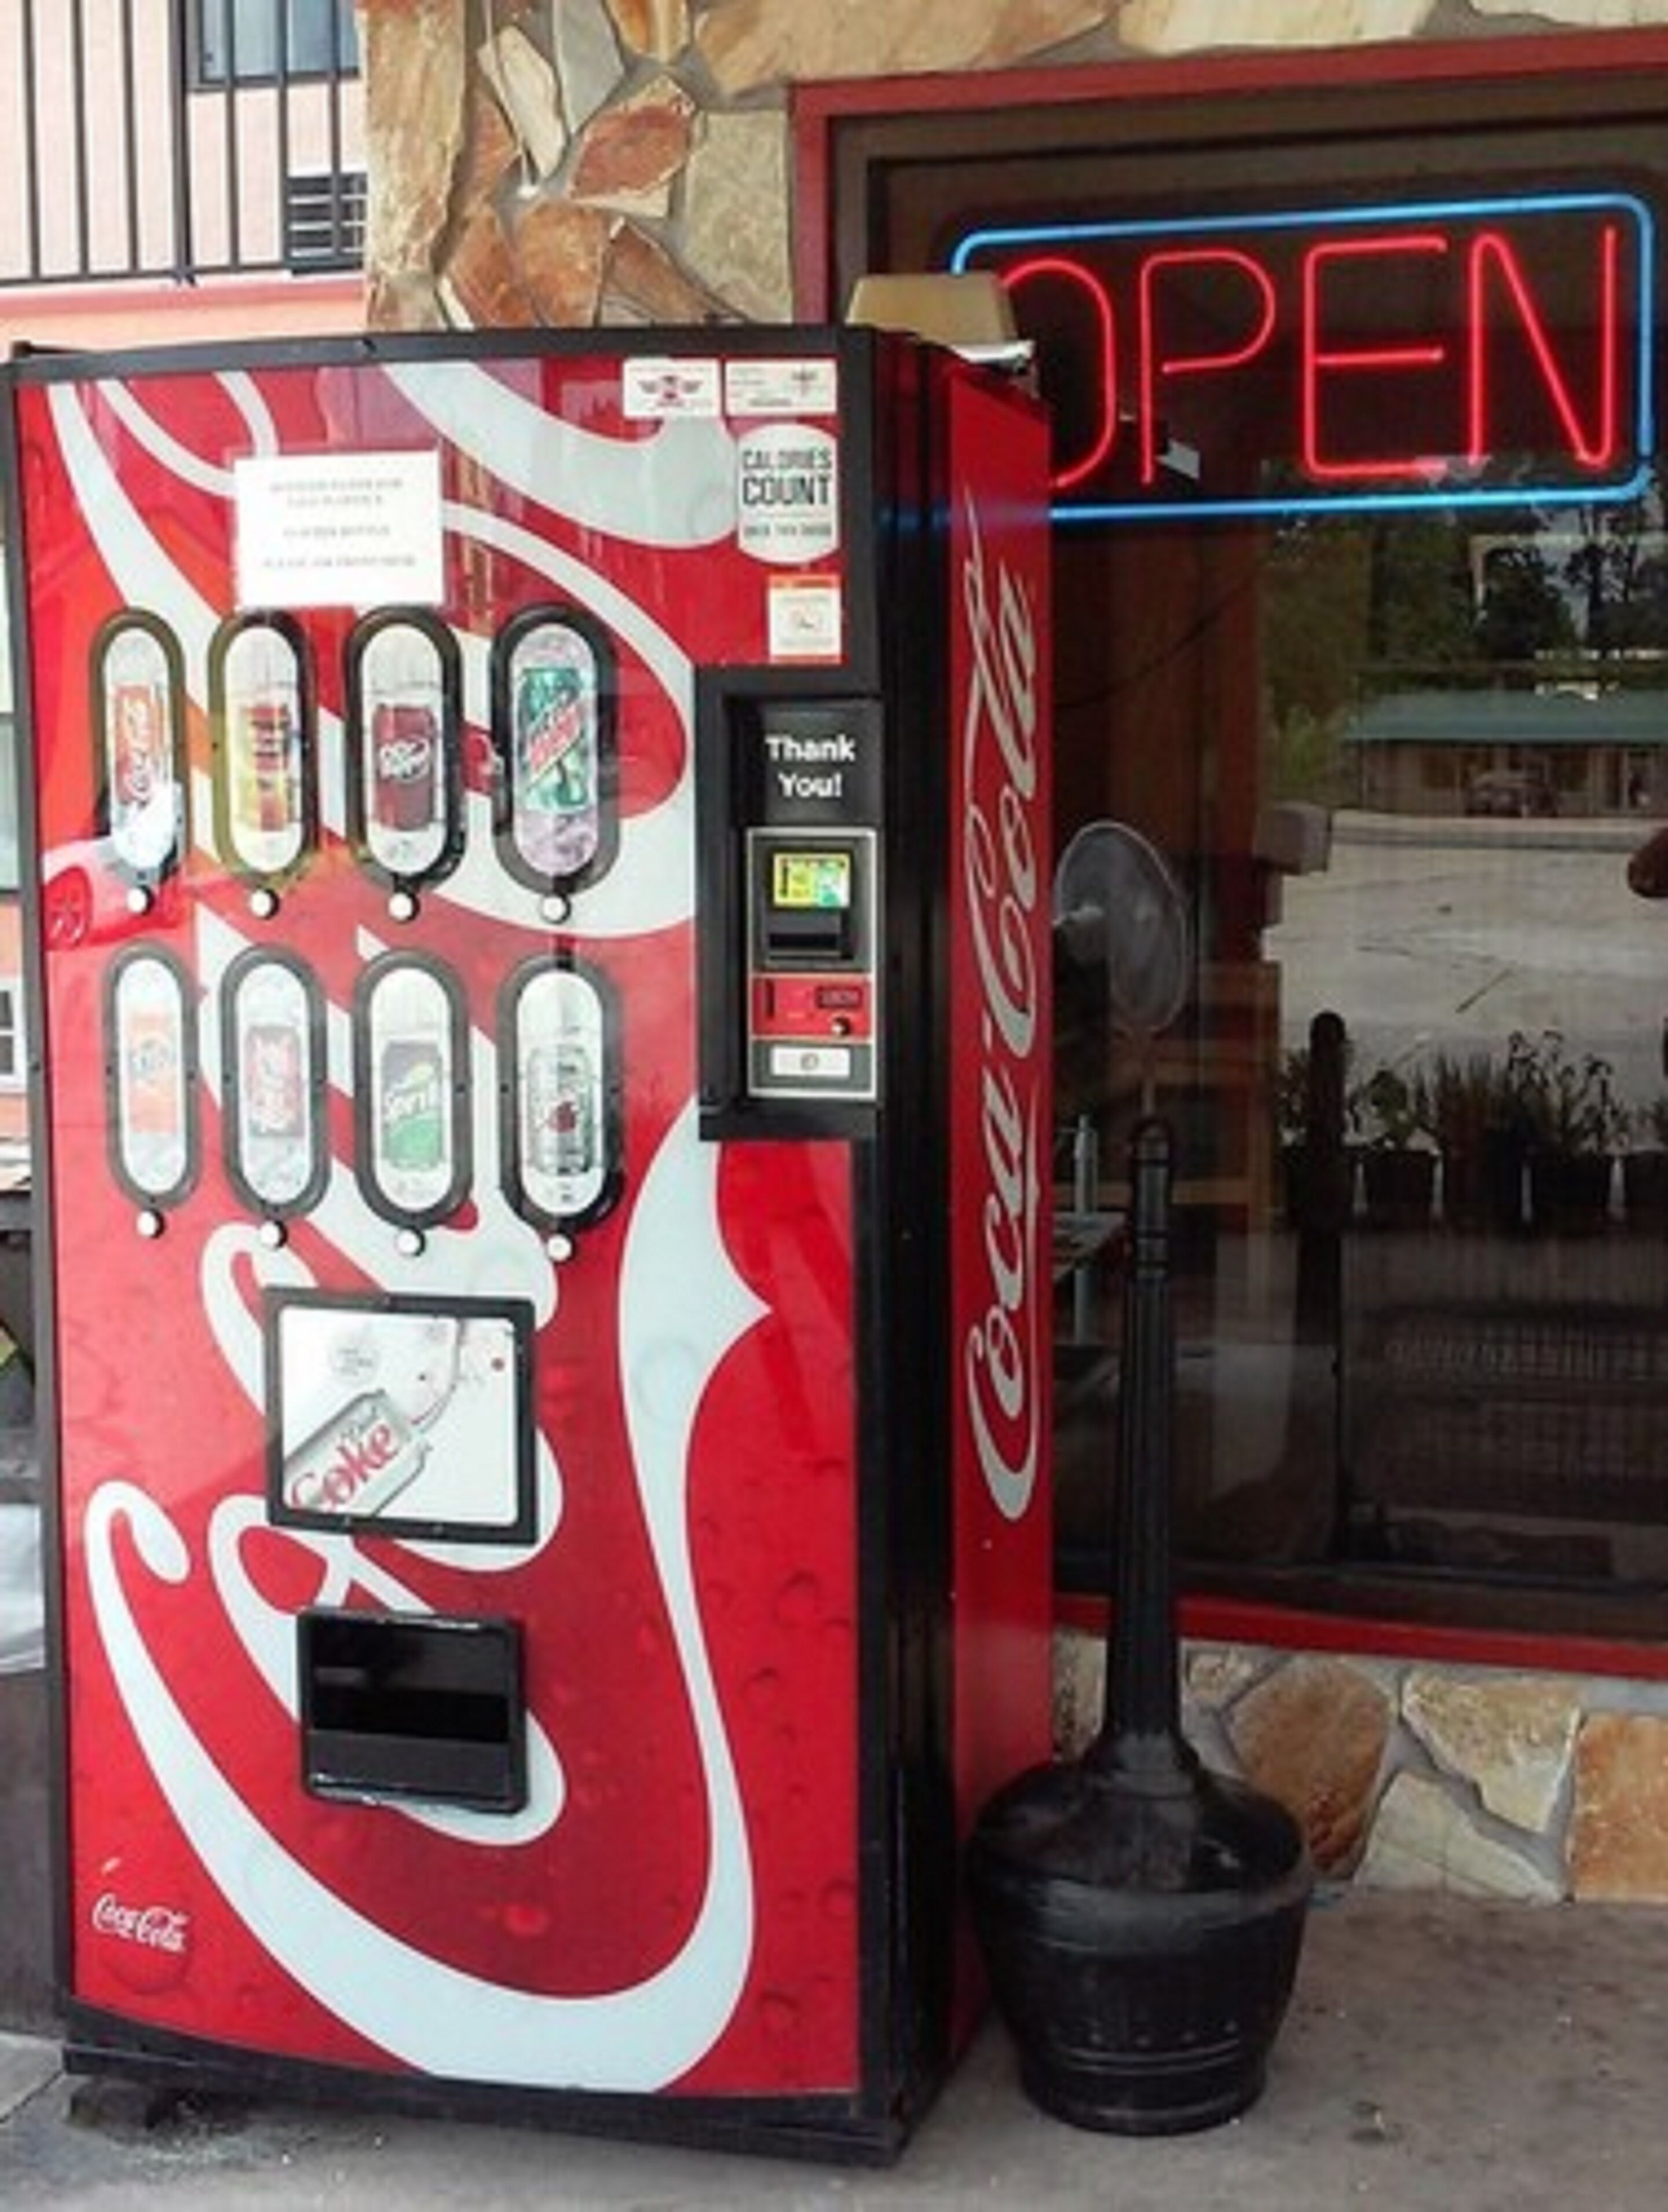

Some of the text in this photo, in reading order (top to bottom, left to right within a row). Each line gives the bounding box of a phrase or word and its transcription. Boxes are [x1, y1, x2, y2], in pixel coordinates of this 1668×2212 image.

[997, 224, 1621, 490] OPEN
[742, 448, 833, 470] CALORIES
[742, 476, 832, 504] COUNT
[765, 734, 857, 762] Thank
[778, 773, 843, 798] You!
[964, 484, 1038, 1520] Coca-Cola
[92, 1892, 189, 1954] Coca-Cola
